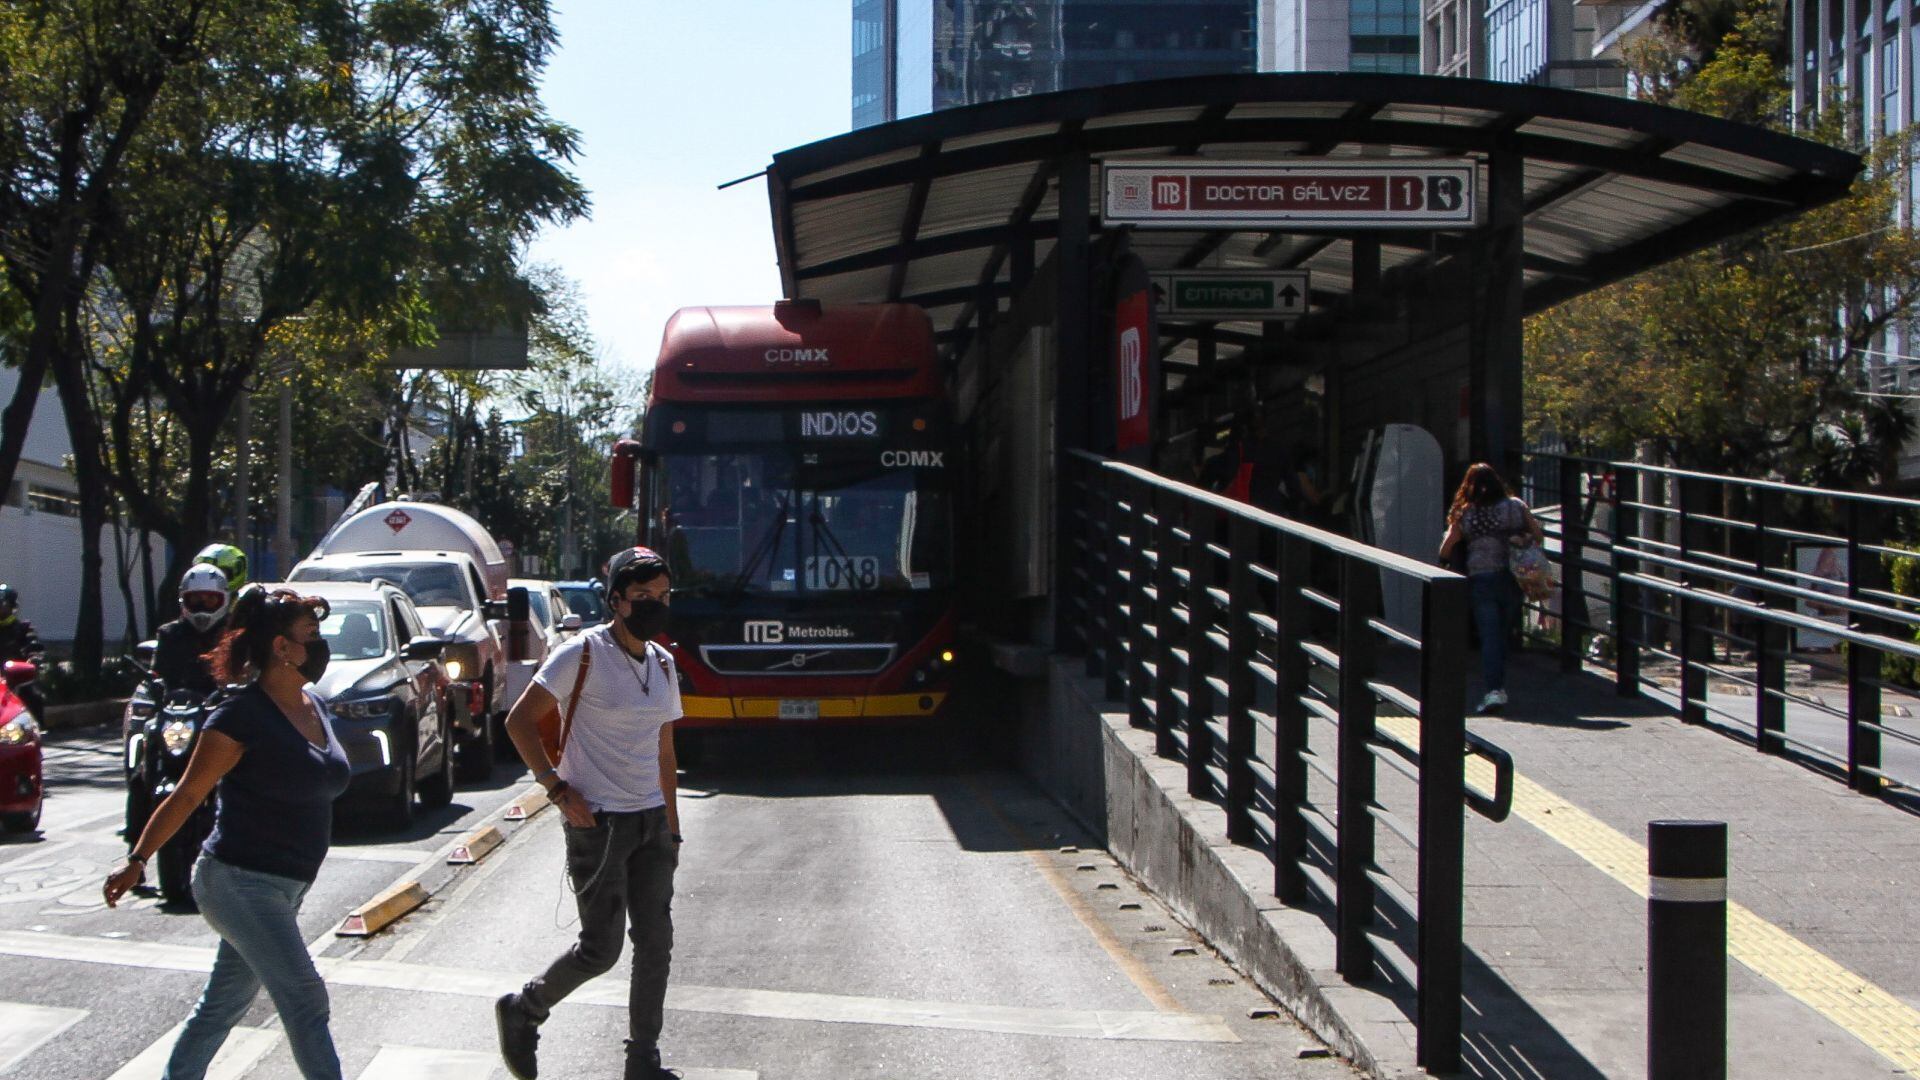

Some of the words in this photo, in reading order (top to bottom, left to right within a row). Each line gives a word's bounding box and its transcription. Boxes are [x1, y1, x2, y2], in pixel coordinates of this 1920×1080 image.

[1205, 185, 1284, 201] DOCTOR
[1292, 181, 1371, 201] GÁLVEZ
[1402, 181, 1412, 206] 1
[1185, 287, 1265, 301] ENTRADA
[764, 348, 829, 363] CDMX
[801, 411, 878, 436] INDIOS
[880, 450, 944, 468] CDMX
[807, 558, 876, 588] 1018
